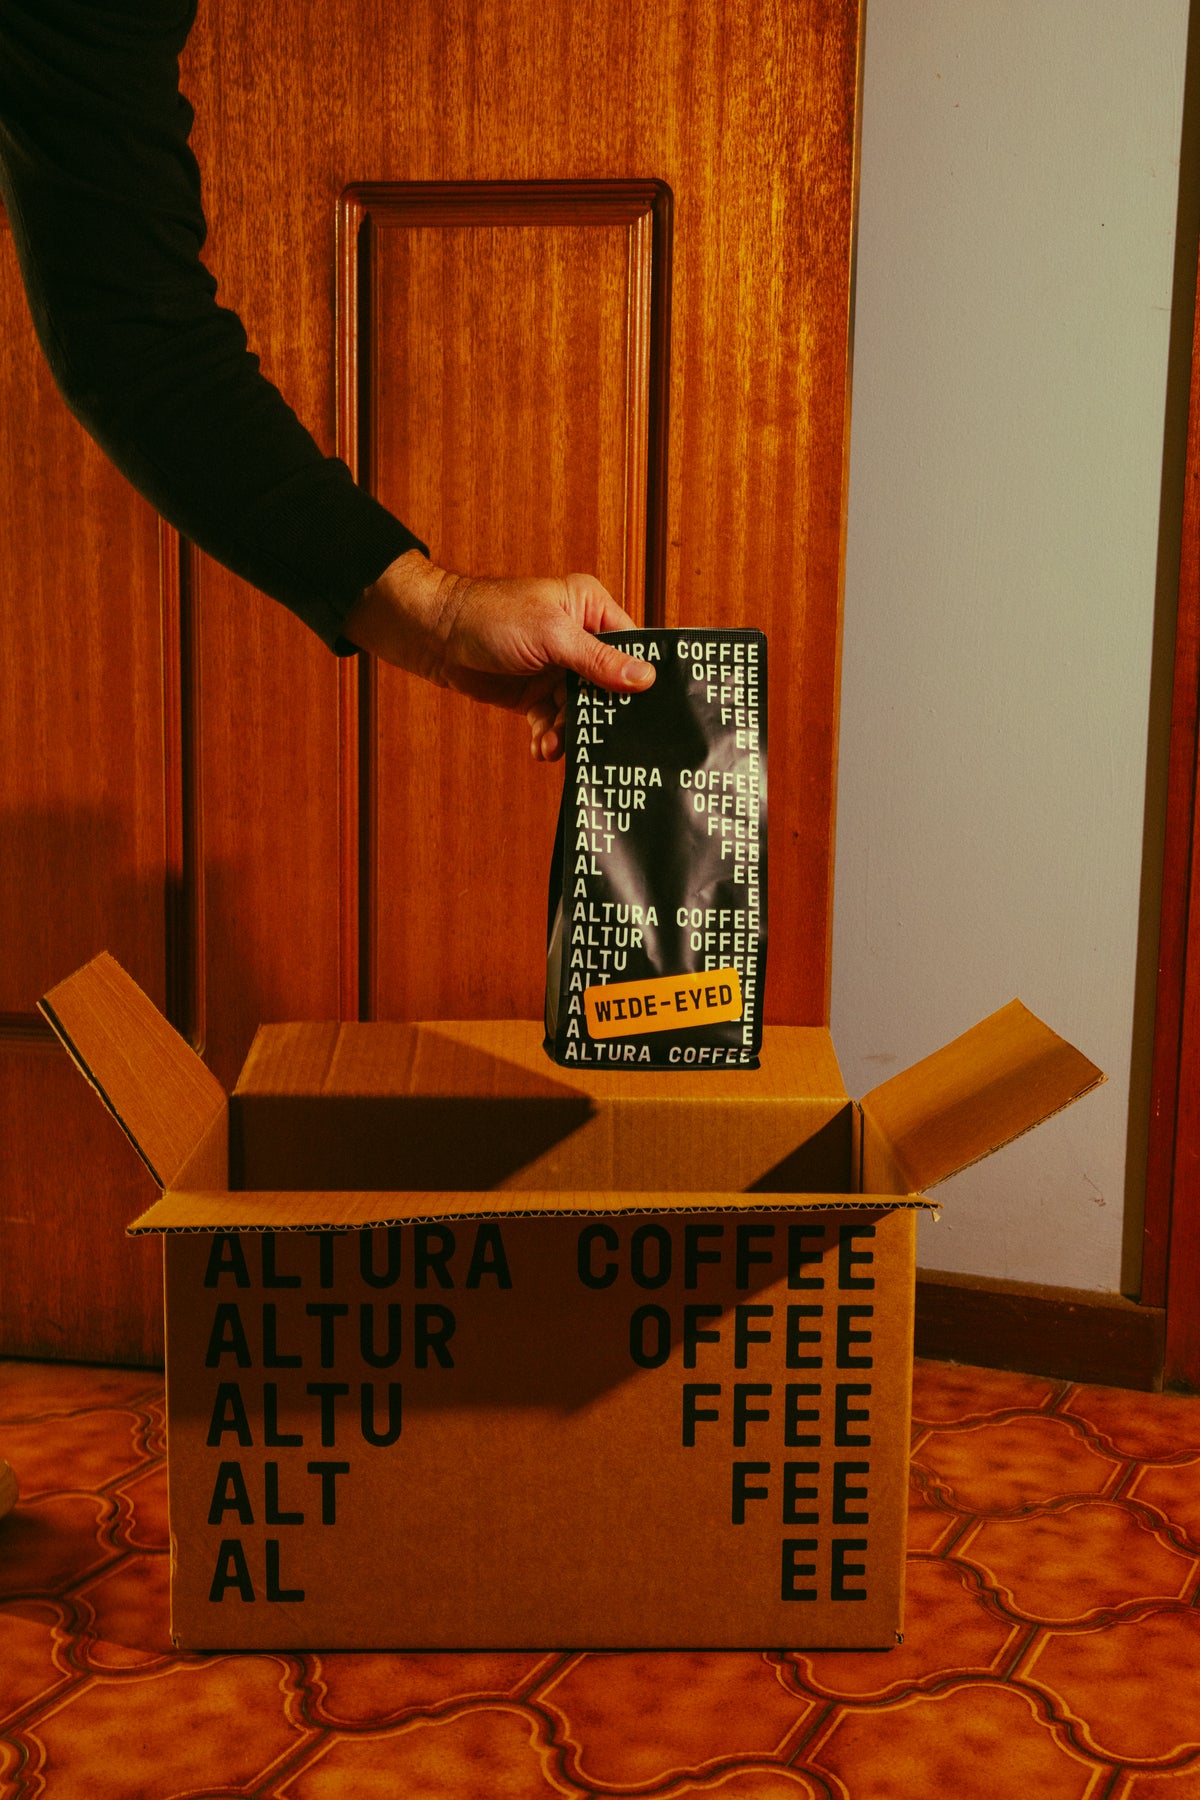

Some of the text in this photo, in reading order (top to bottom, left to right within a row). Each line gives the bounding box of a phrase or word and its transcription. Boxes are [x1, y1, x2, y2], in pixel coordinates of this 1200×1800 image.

[677, 641, 759, 664] COFFEE
[692, 663, 759, 685] OFFEE
[706, 685, 759, 707] FFEE
[577, 707, 759, 729] ALT FEE
[576, 727, 759, 751] AL EE
[576, 747, 759, 773] A E
[576, 765, 759, 795] ALTURA COFFEE
[576, 787, 759, 817] ALTUR OFFEE
[576, 809, 759, 840] ALTU FFEE
[575, 831, 759, 862] ALT FEE
[574, 855, 759, 885] AL EE
[573, 878, 759, 907] A E
[572, 901, 760, 930] ALTURA COFFEE
[571, 925, 759, 953] ALTUR OFFEE
[570, 948, 627, 971] ALTU
[568, 995, 755, 1022] A E
[594, 984, 733, 1023] WIDE-EYED
[566, 1018, 754, 1046] A E
[565, 1041, 752, 1064] ALTURA COFFEE
[203, 1223, 877, 1291] ALTURA COFFEE
[205, 1303, 875, 1370] ALTUR OFFEE
[206, 1382, 872, 1448] ALTU FFEE
[207, 1461, 870, 1526] ALT FEE
[208, 1539, 868, 1602] AL EE
